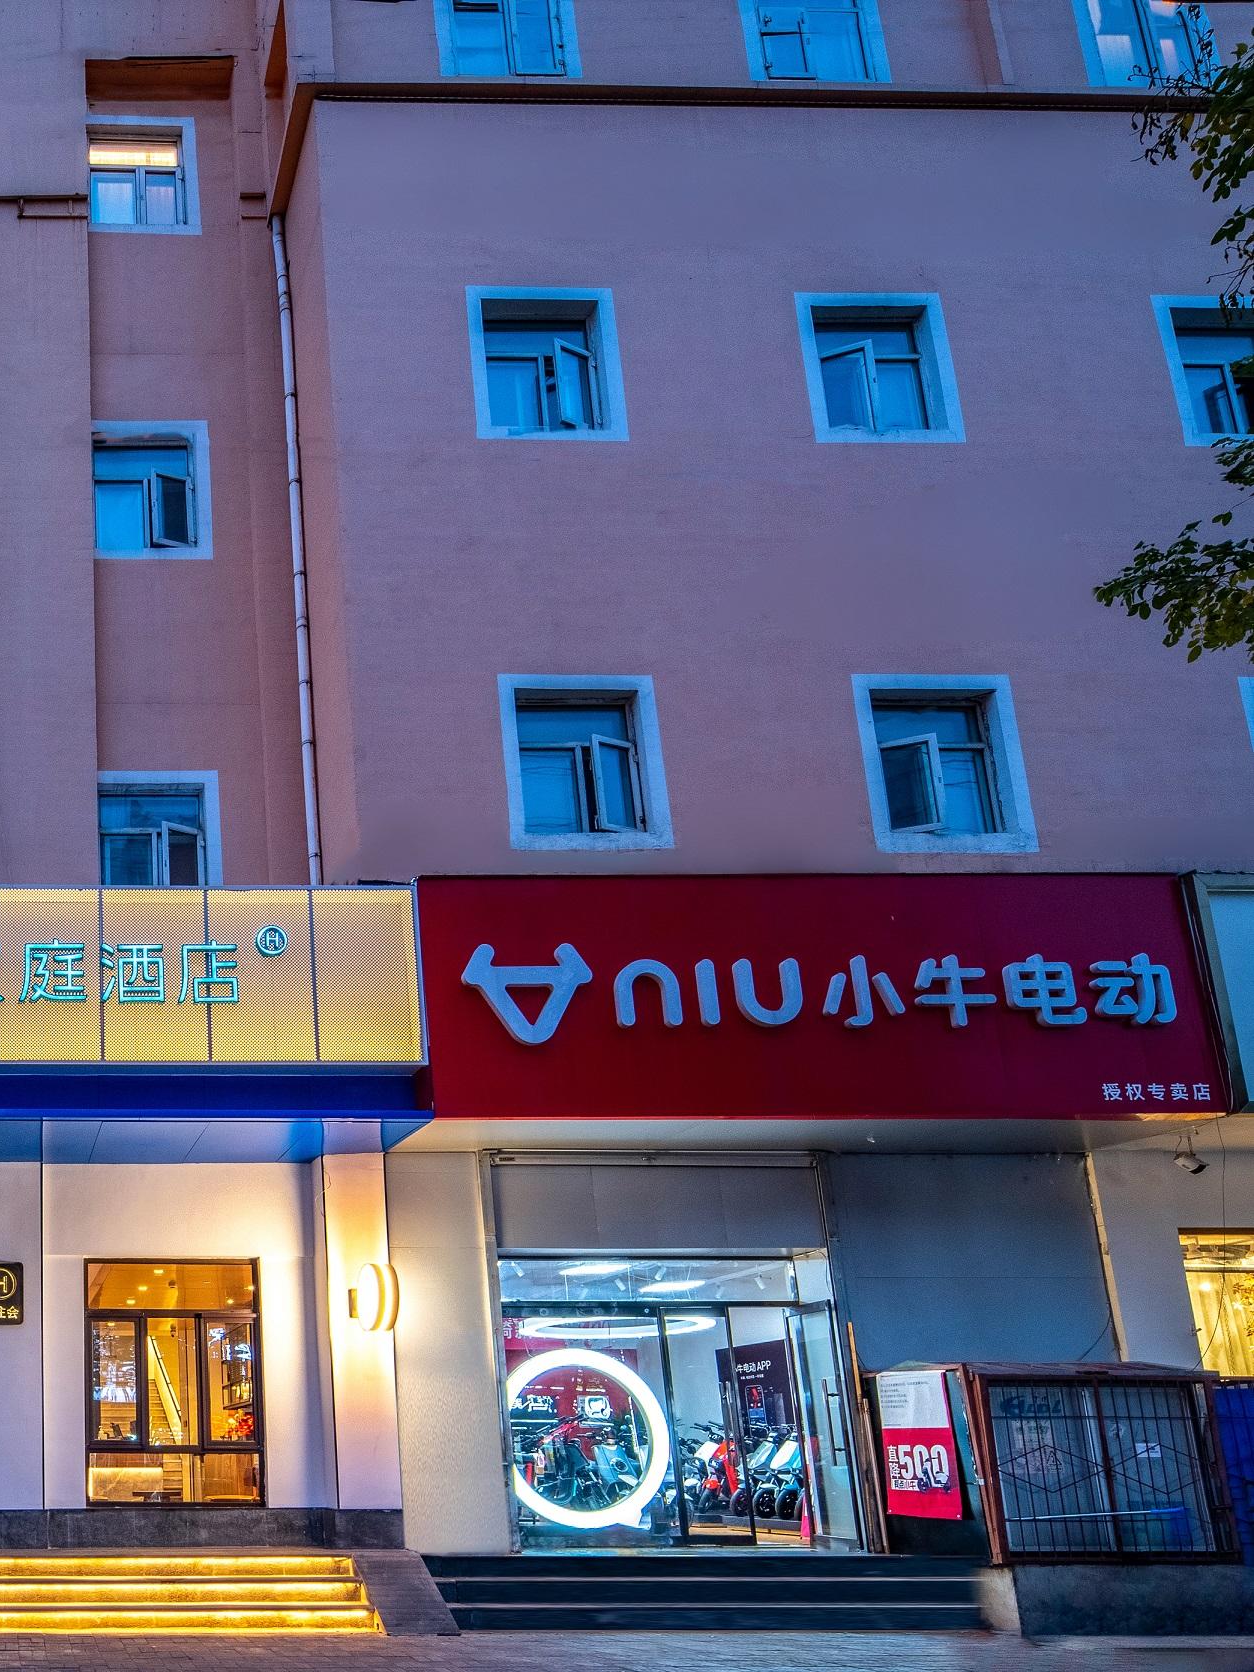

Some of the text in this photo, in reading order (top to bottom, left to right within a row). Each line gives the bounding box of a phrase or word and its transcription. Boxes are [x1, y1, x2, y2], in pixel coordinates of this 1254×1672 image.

[822, 952, 1178, 1029] 小牛电动
[1102, 1083, 1211, 1101] 授权专卖店
[735, 1360, 771, 1374] 牛电动 APP
[898, 1444, 950, 1481] 500
